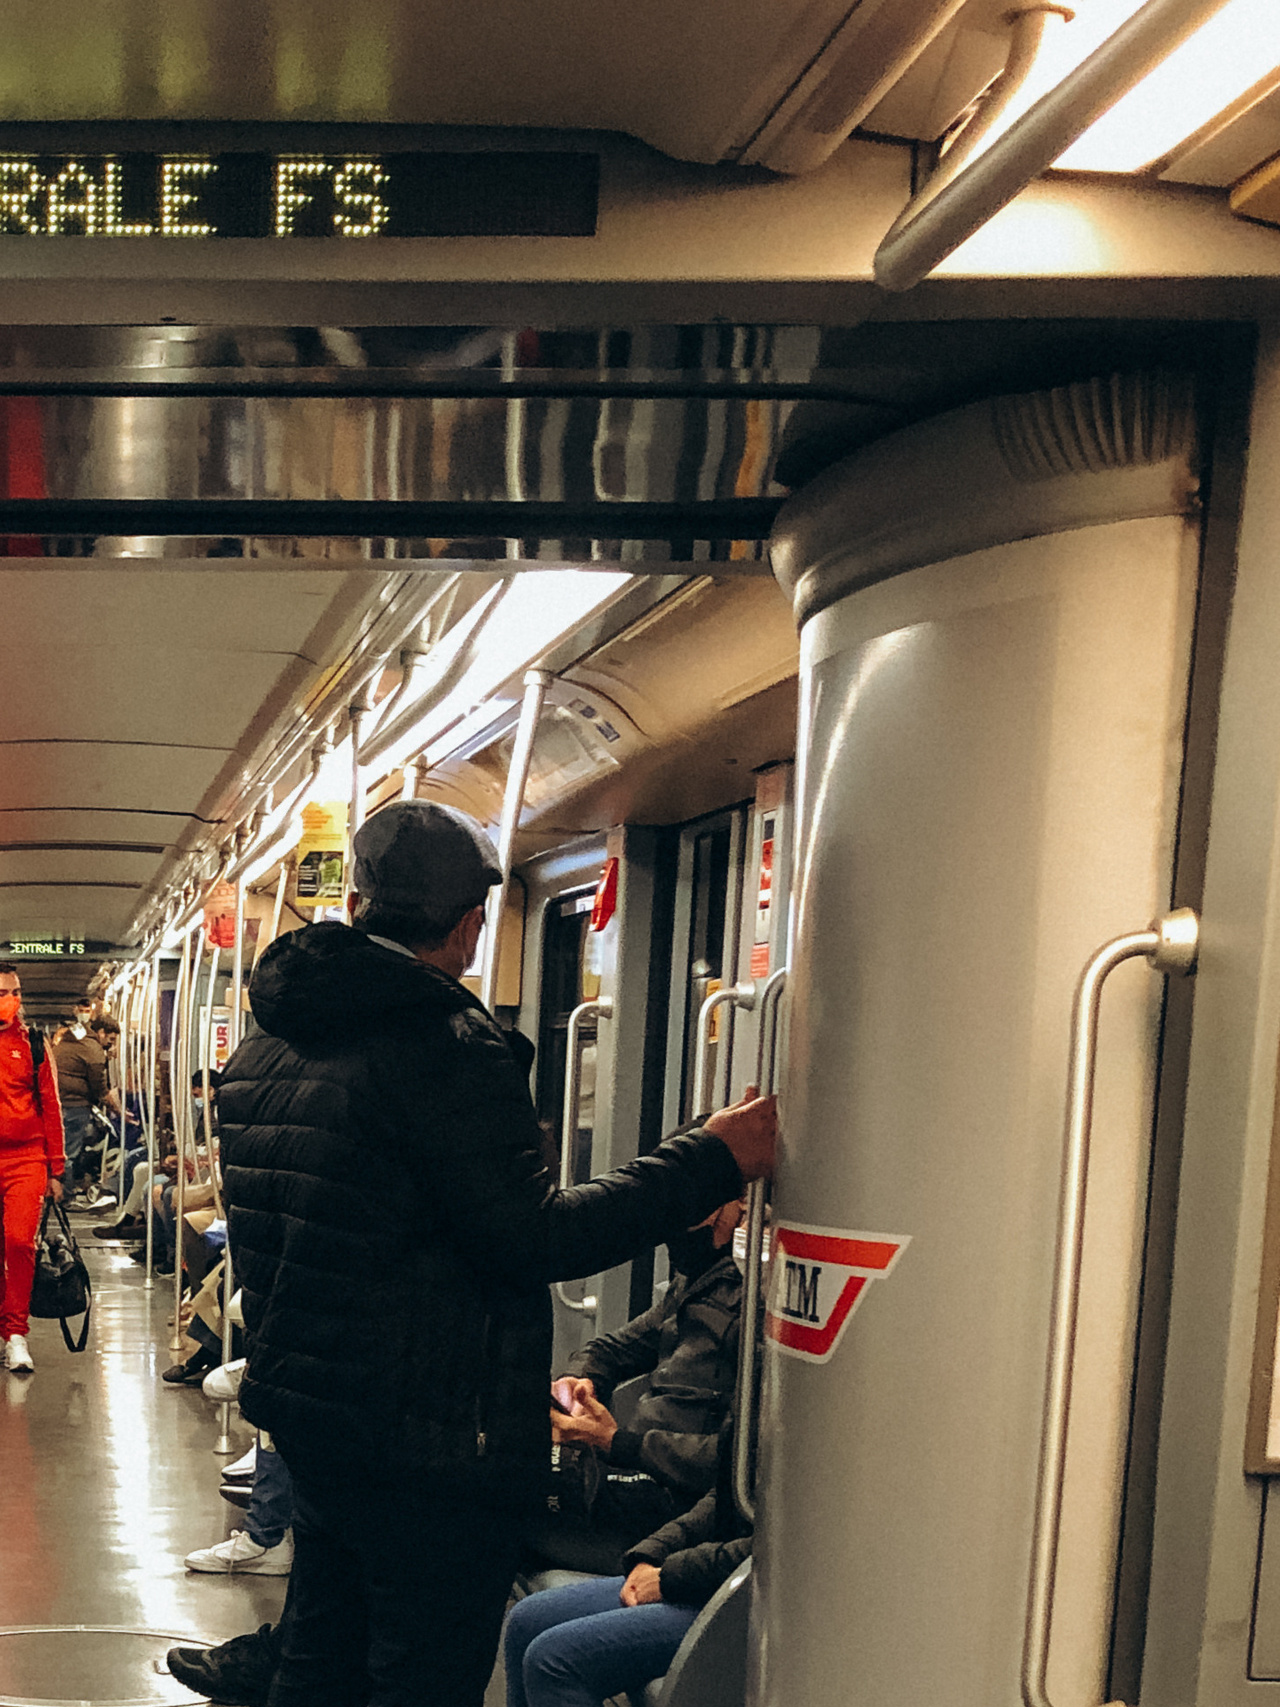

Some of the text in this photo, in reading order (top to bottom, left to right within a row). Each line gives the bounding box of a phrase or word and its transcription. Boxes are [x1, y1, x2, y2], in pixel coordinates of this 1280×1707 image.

[276, 161, 390, 235] FS
[69, 942, 85, 955] FS
[781, 1259, 822, 1323] TM
